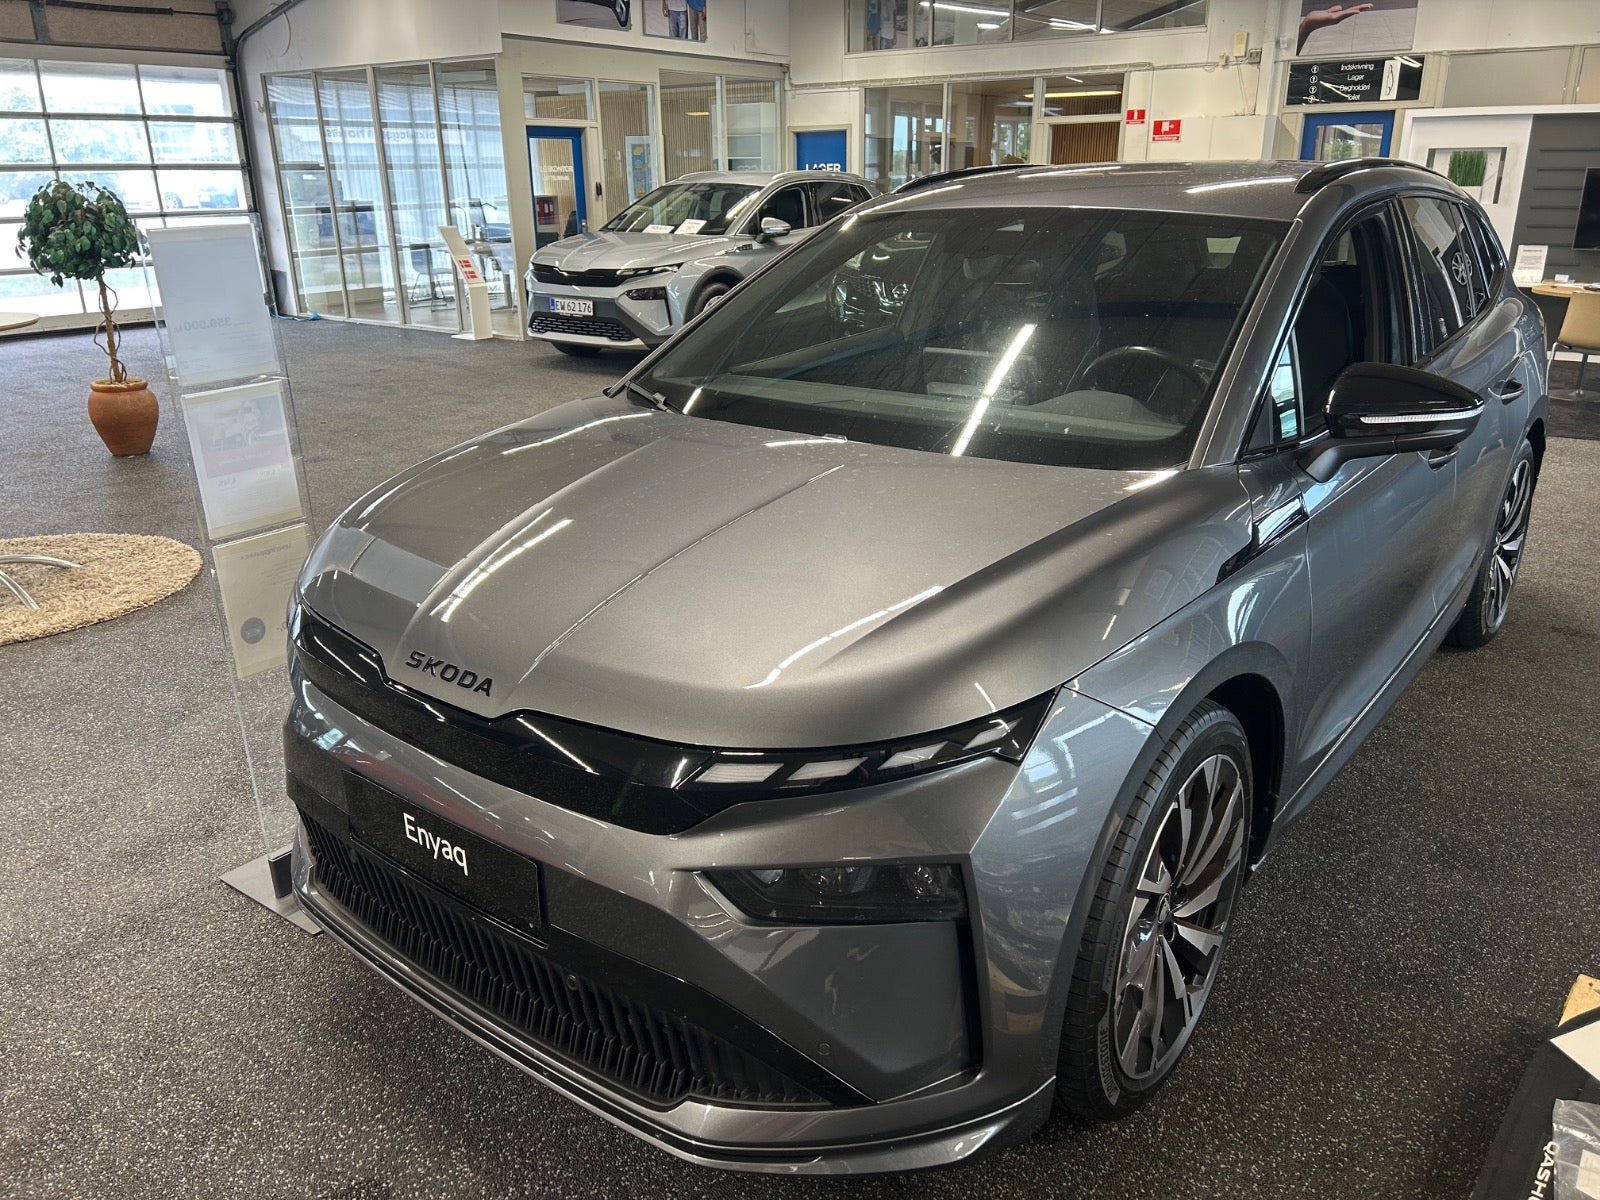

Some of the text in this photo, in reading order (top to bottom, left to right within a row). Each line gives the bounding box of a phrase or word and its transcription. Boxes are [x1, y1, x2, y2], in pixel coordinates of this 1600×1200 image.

[1340, 63, 1375, 71] Indskrivning
[567, 301, 576, 312] 62
[578, 302, 592, 313] 176
[403, 812, 469, 877] Enyaq
